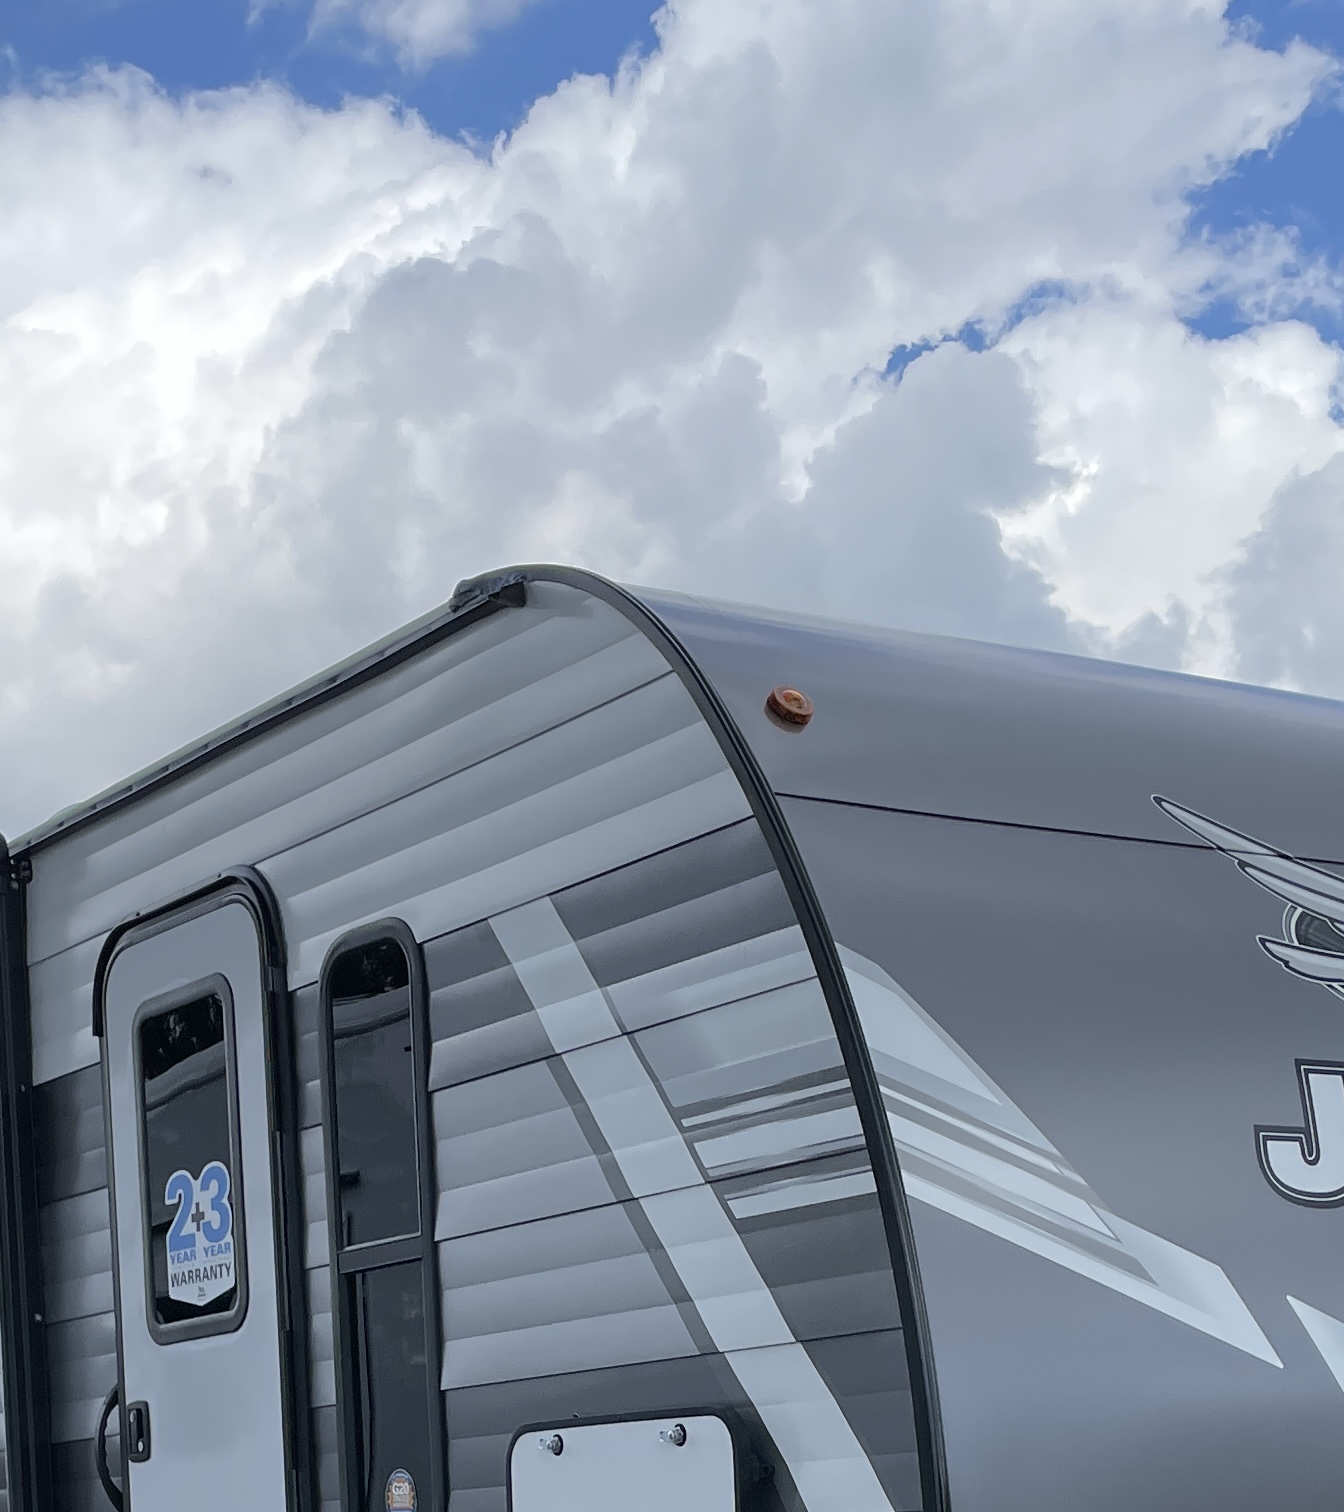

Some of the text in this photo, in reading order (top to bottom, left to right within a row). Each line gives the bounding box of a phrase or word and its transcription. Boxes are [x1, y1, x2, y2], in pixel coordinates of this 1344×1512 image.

[170, 1248, 197, 1265] YEAR
[203, 1242, 232, 1258] YEAR
[170, 1262, 232, 1288] WARRANTY
